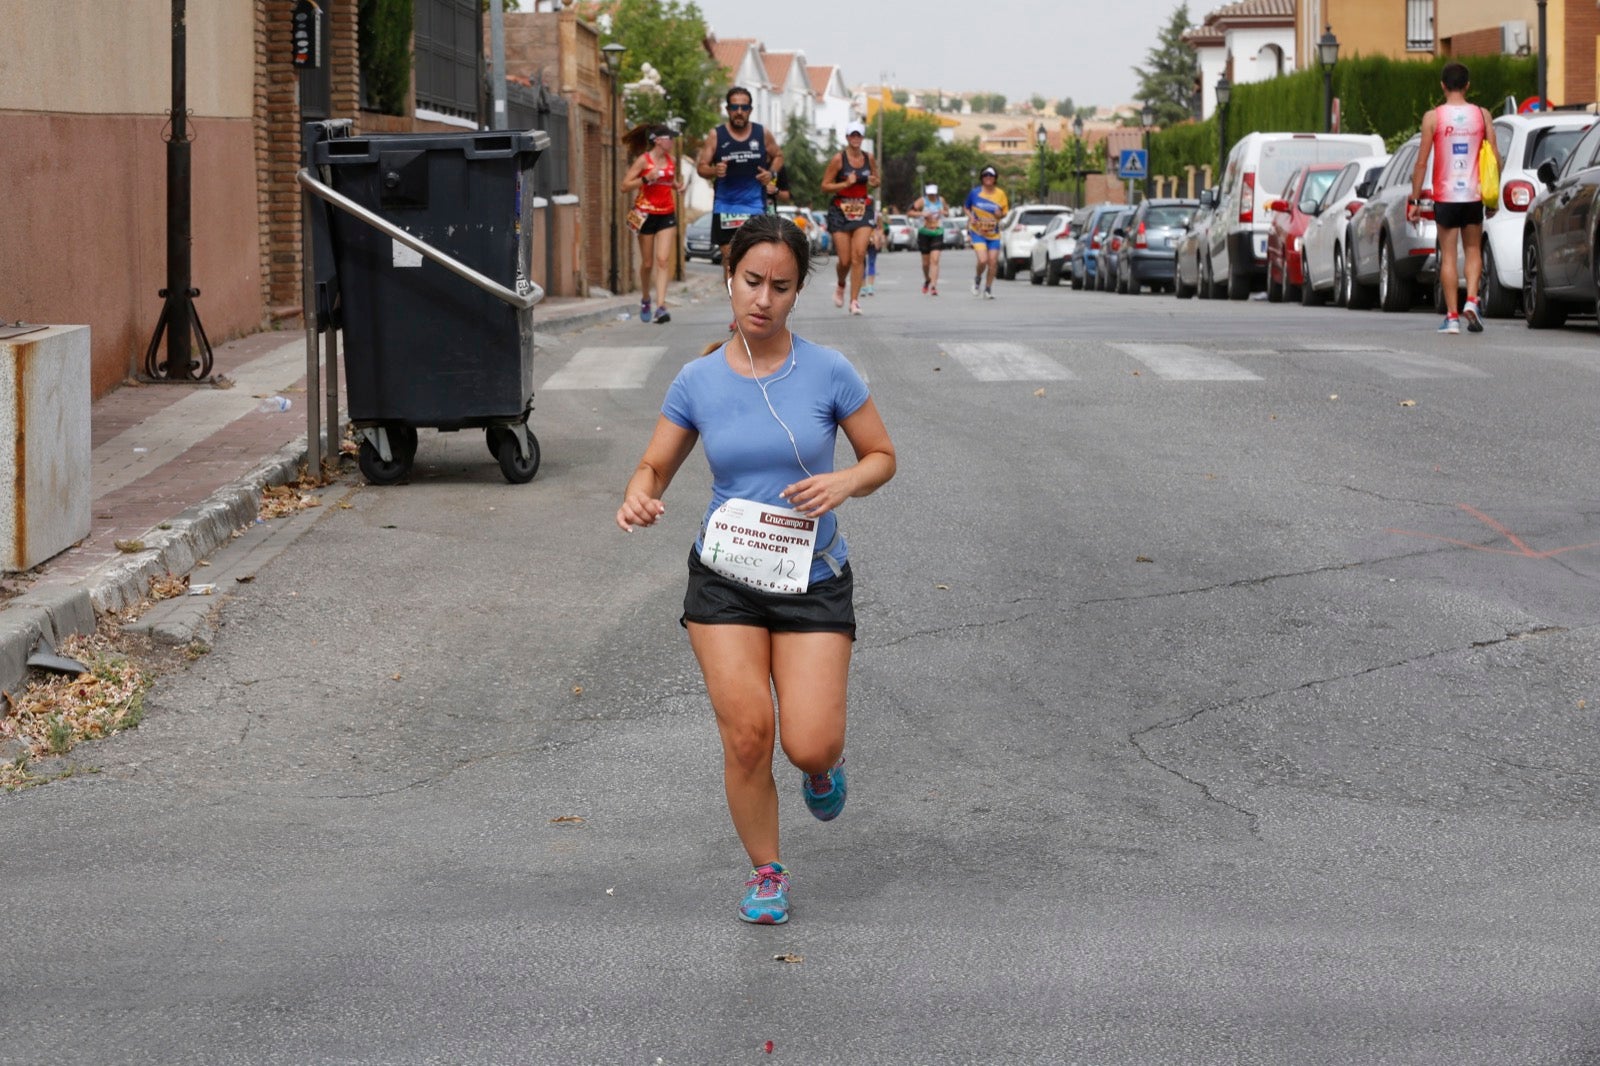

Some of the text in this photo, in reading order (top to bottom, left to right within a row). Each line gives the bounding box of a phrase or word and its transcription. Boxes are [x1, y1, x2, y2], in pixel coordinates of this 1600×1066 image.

[764, 513, 804, 529] Cruzcampo
[715, 521, 810, 547] YO CORRO CONTRA
[732, 536, 788, 554] EL CANCER
[725, 552, 763, 568] aecc
[773, 558, 797, 581] 12
